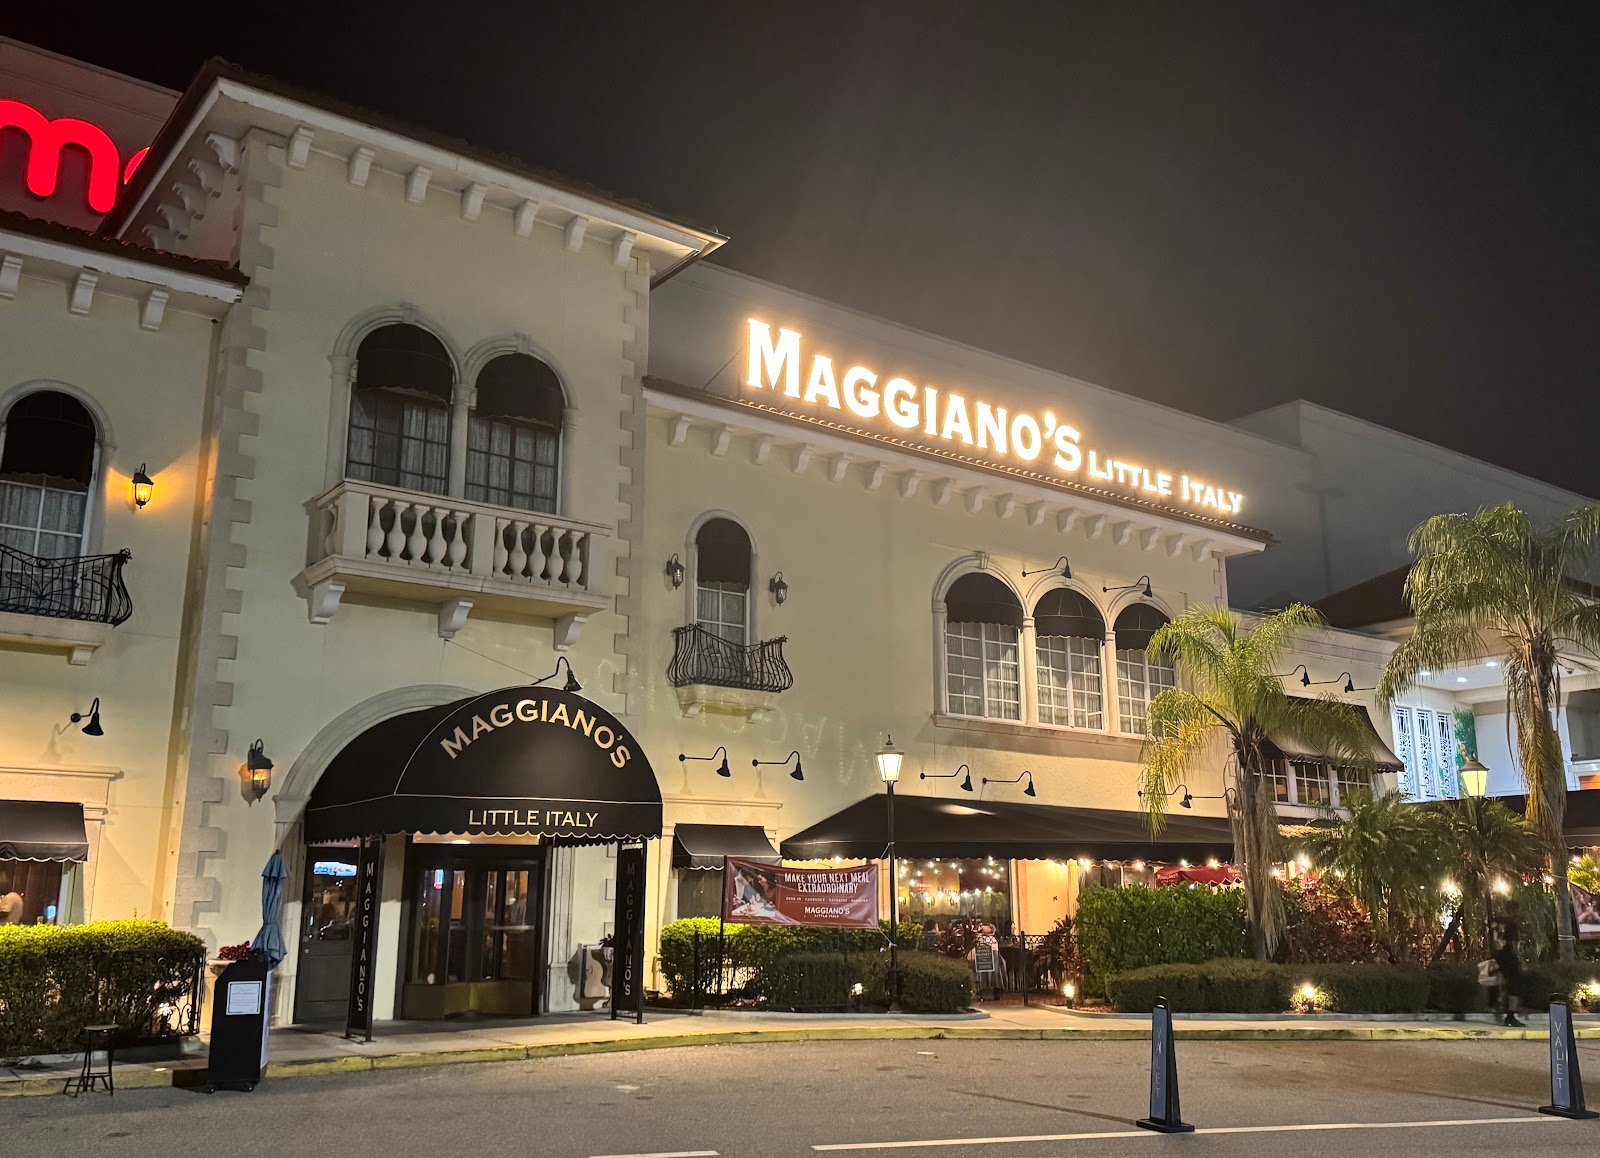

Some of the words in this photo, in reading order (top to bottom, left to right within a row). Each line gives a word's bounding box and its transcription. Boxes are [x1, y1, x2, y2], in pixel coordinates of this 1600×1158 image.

[746, 317, 1083, 473] MAGGIANO'S
[1088, 449, 1173, 496] LITTLE
[1181, 473, 1243, 514] ITALY
[439, 699, 632, 769] MAGGIANO'S
[468, 809, 540, 827] LITTLE
[545, 810, 599, 828] ITALY
[784, 872, 806, 883] MAKE
[807, 873, 828, 883] YOUR
[829, 873, 848, 883] NEXT
[850, 871, 870, 883] MEAL
[797, 882, 859, 894] EXTRAORDINARY
[804, 906, 850, 915] MAGGIANO'S
[357, 862, 374, 1012] MAGGIANO'S
